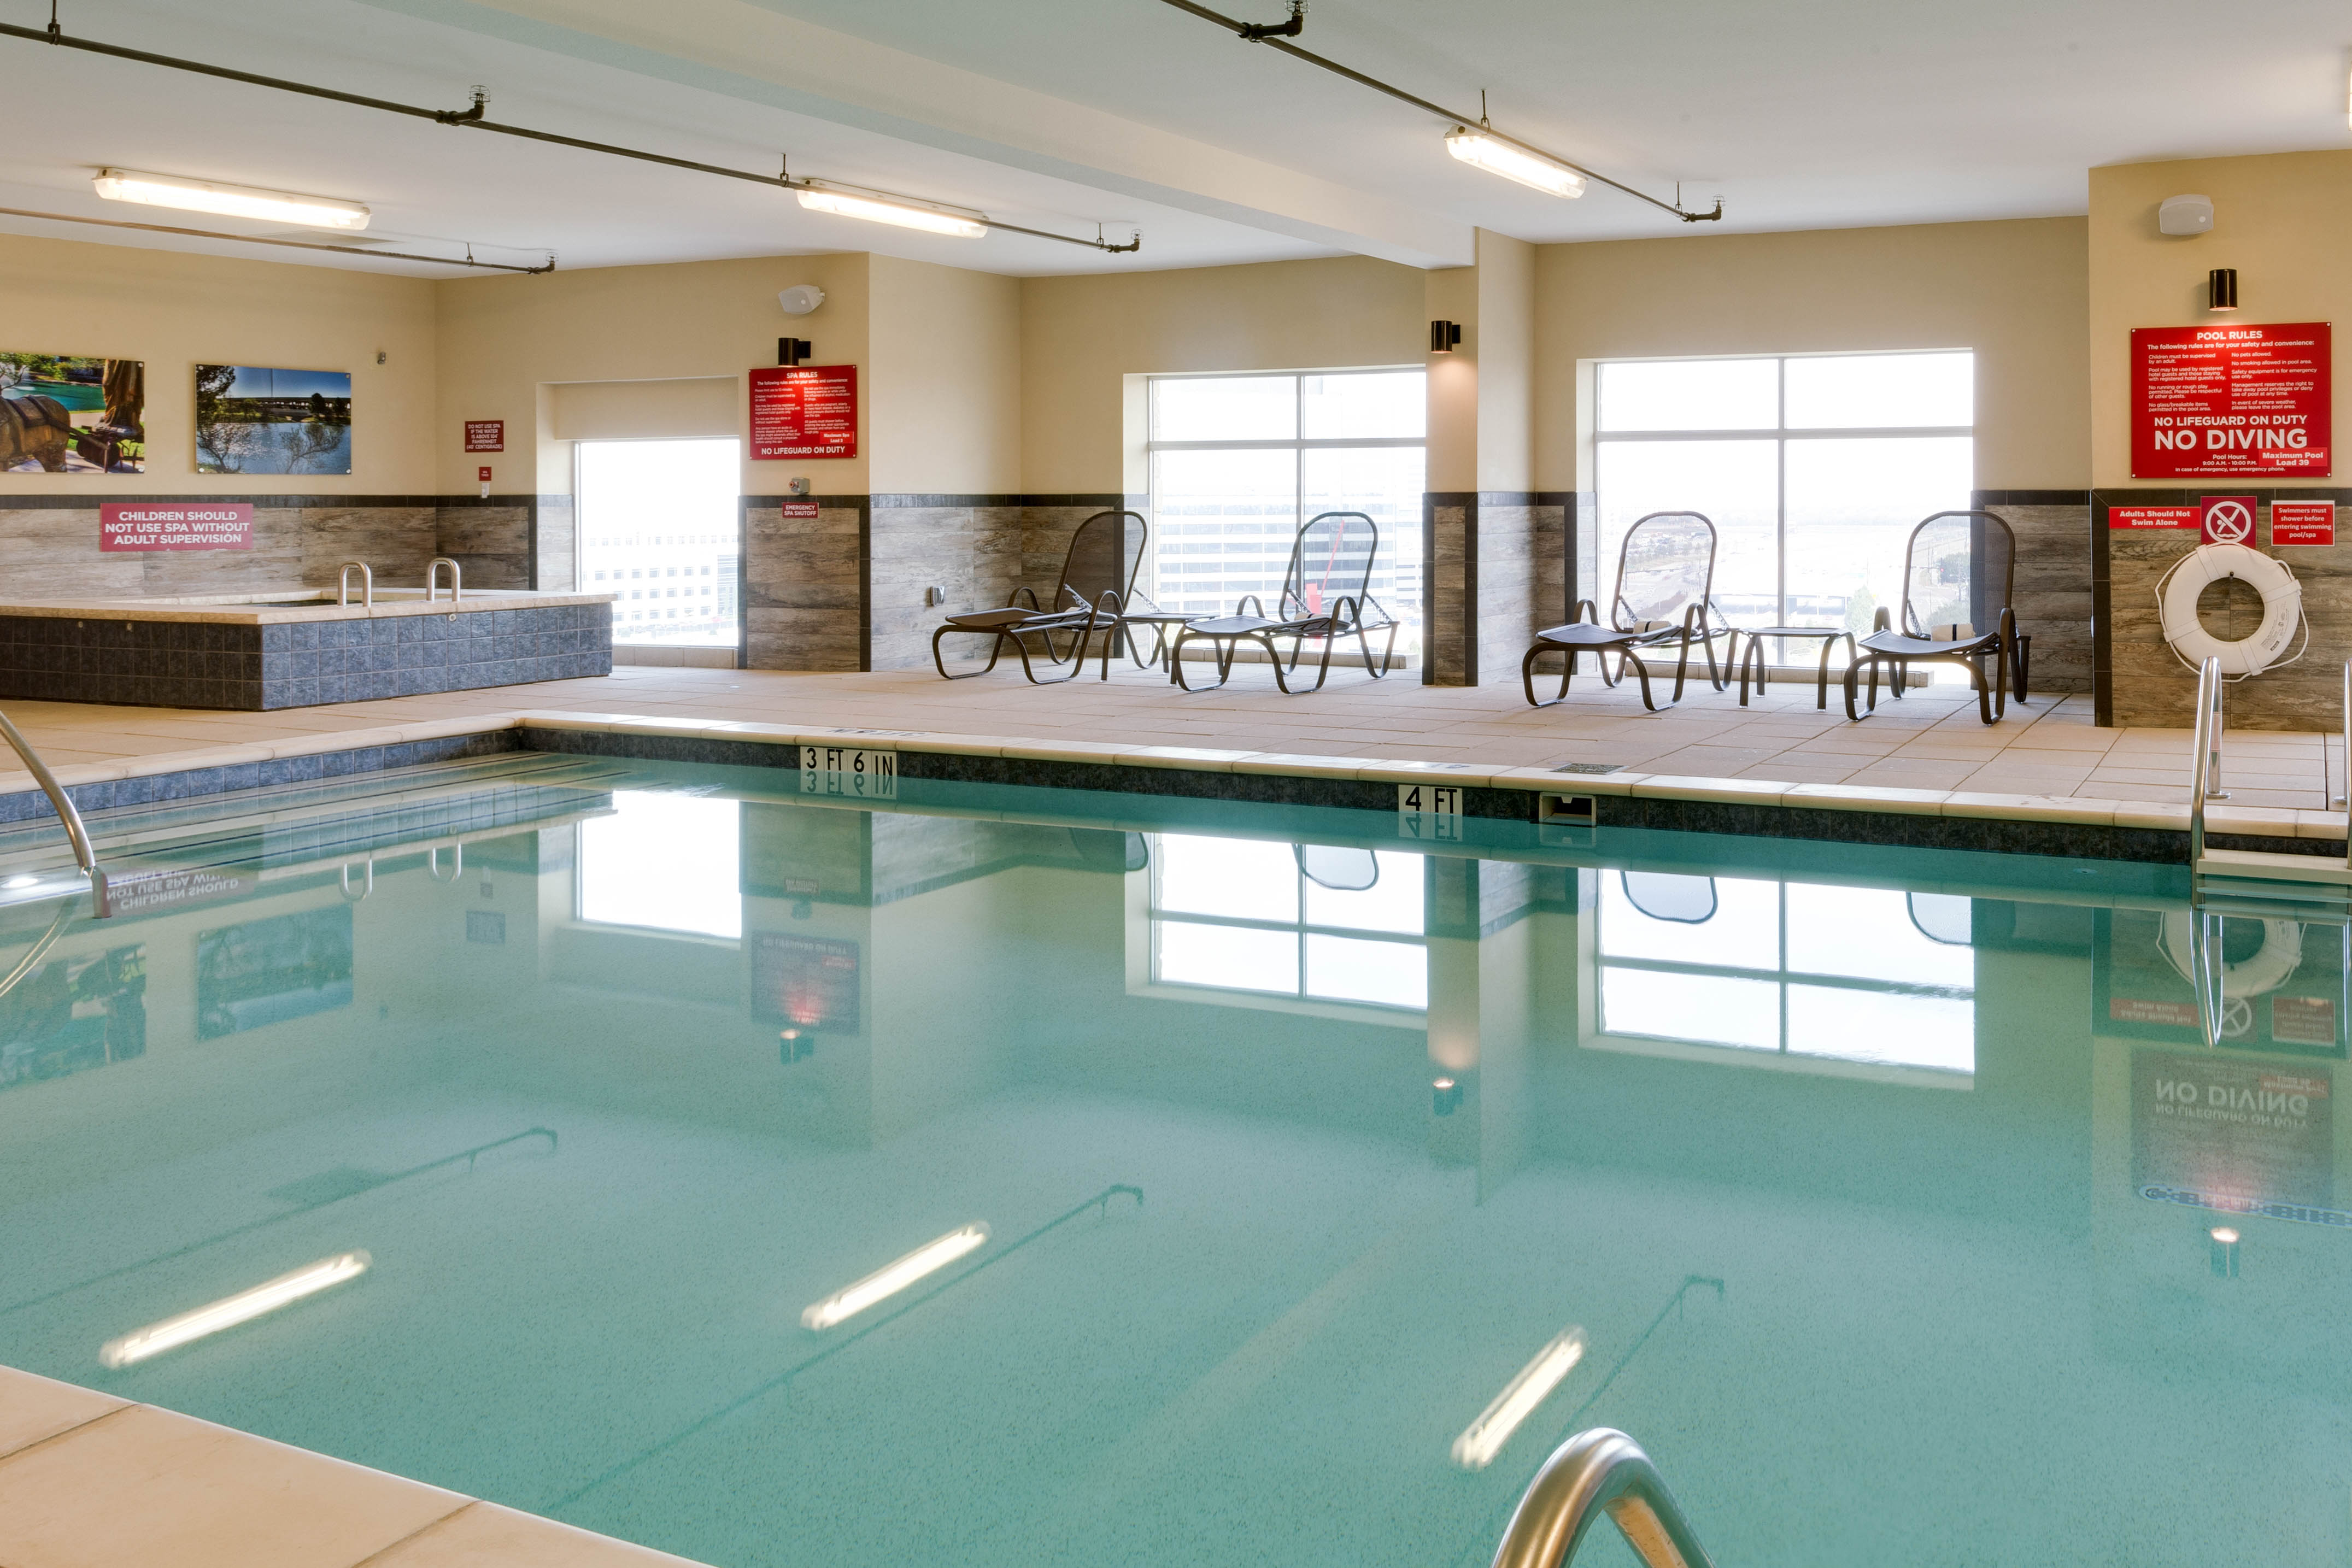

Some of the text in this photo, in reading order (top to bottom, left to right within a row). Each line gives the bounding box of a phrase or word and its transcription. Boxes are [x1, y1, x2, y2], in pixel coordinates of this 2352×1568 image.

[2197, 330, 2262, 340] POOL RULES
[2154, 415, 2307, 426] NO LIFEGUARD ON DUTY
[2155, 428, 2307, 450] NO DIVING
[119, 512, 237, 521] CHILDREN SHOULD
[105, 522, 249, 533] NOT USE SPA WITHOUT
[114, 534, 242, 544] ADULT SUPERVISION
[807, 748, 892, 776] 3 FT 6 IN
[1405, 786, 1457, 813] 4 FT
